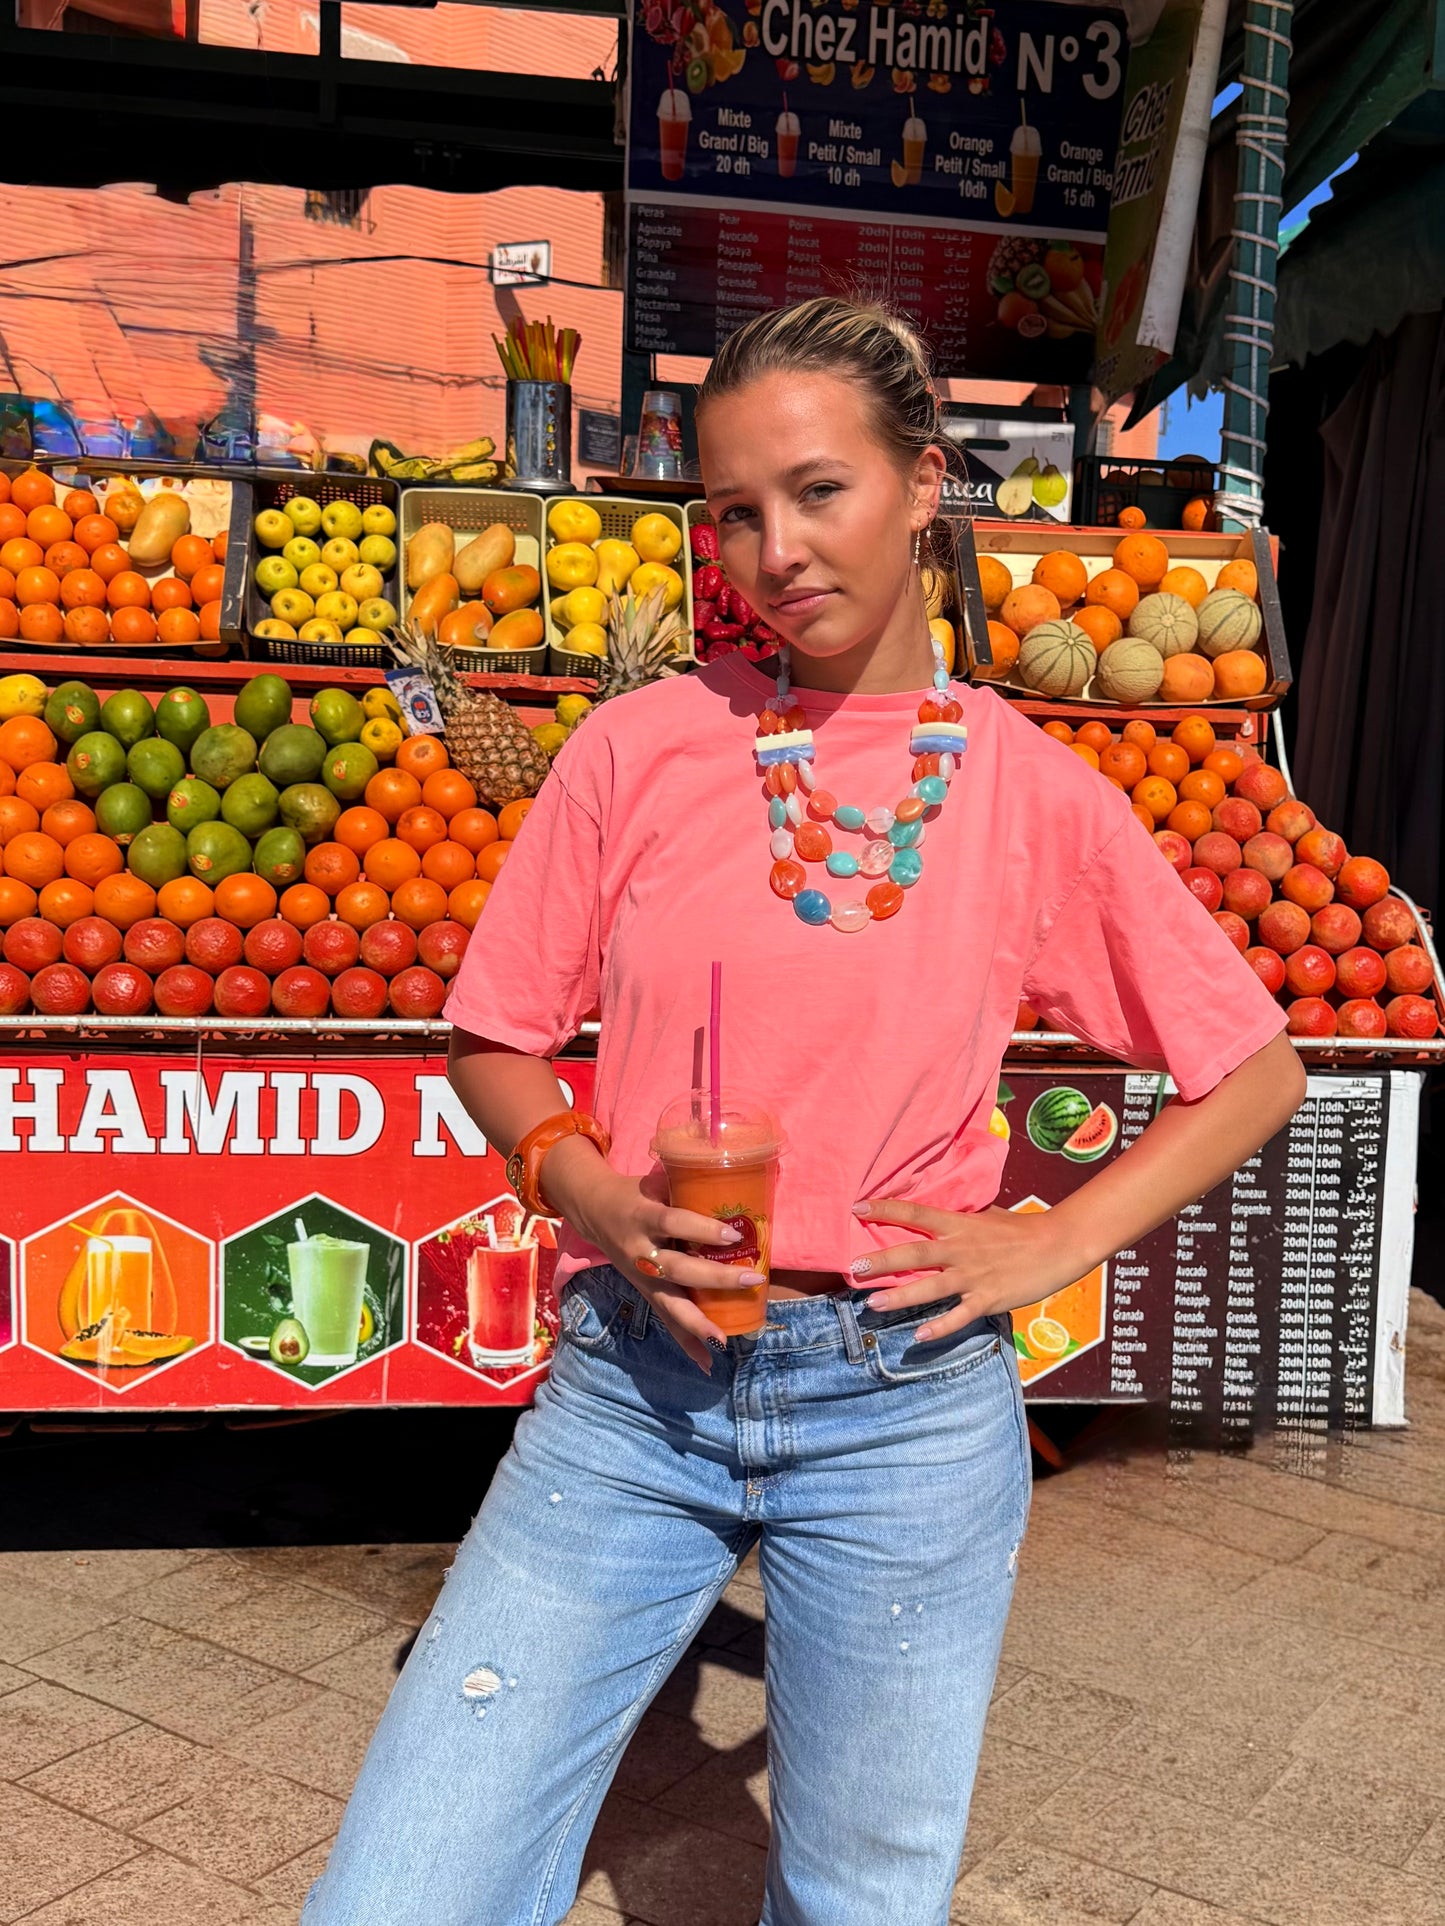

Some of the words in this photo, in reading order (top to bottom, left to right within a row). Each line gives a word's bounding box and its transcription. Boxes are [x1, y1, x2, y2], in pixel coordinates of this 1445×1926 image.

[760, 0, 857, 64] Chez
[868, 4, 988, 76] Hamid
[718, 107, 752, 129] Mixte
[828, 118, 862, 141] Mixte
[699, 129, 740, 154] Grand
[748, 134, 769, 159] Big
[949, 131, 994, 156] Orange
[808, 141, 836, 163] Petit
[846, 145, 881, 167] Small
[1059, 140, 1104, 165] Orange
[716, 155, 731, 174] 20
[733, 154, 751, 176] dh
[935, 154, 963, 177] Petit
[973, 157, 1006, 180] Small
[827, 166, 841, 186] 10
[843, 166, 861, 187] dh
[1047, 163, 1085, 187] Grand
[1094, 168, 1113, 191] Big
[1063, 187, 1078, 207] 15
[1078, 188, 1096, 208] dh
[638, 206, 664, 218] Peras
[718, 213, 740, 226] Pear
[788, 219, 813, 232] Poire
[858, 226, 889, 237] 20dh
[895, 228, 925, 240] 10dh
[638, 222, 682, 237] Aguacate
[718, 230, 759, 243] Avocado
[787, 235, 819, 248] Avocat
[637, 235, 672, 250] Papaya
[717, 244, 752, 258] Papaya
[717, 258, 763, 274] Pineapple
[636, 267, 676, 281] Granada
[717, 276, 757, 289] Grenade
[635, 298, 681, 312] Nectarina
[716, 291, 773, 305] Watermelon
[635, 310, 661, 323] Fresa
[635, 324, 668, 338] Mango
[1124, 1094, 1152, 1108] Naranja
[1320, 1101, 1344, 1112] 10dh
[0, 1067, 386, 1156] HAMID
[1123, 1109, 1149, 1120] Pomelo
[1320, 1115, 1344, 1124] 10dh
[1122, 1123, 1144, 1135] Limon
[1289, 1127, 1314, 1138] 20dh
[1318, 1128, 1343, 1138] 10dh
[1288, 1143, 1313, 1153] 20dh
[1317, 1144, 1342, 1154] 10dh
[1288, 1158, 1312, 1167] 20dh
[1316, 1158, 1341, 1168] 10dh
[1233, 1171, 1256, 1183] Peche
[1287, 1173, 1311, 1183] 20dh
[1316, 1174, 1340, 1184] 10dh
[1232, 1187, 1267, 1199] Pruneaux
[1286, 1189, 1310, 1199] 20dh
[1315, 1190, 1340, 1200] 10dh
[1232, 1203, 1272, 1217] Gingembre
[1285, 1206, 1310, 1216] 20dh
[1314, 1207, 1339, 1217] 10dh
[1178, 1220, 1217, 1232] Persimmon
[1231, 1221, 1247, 1232] Kaki
[1284, 1222, 1309, 1232] 20dh
[1313, 1223, 1338, 1234] 10dh
[1177, 1235, 1194, 1246] Kiwi
[1230, 1236, 1246, 1247] Kiwi
[1283, 1237, 1308, 1247] 20dh
[1312, 1238, 1337, 1248] 10dh
[1176, 1249, 1194, 1261] Pear
[1229, 1250, 1249, 1262] Poire
[1282, 1251, 1307, 1262] 20dh
[1311, 1252, 1336, 1263] 10dh
[1115, 1265, 1149, 1278] Aguacate
[1176, 1266, 1207, 1277] Avocado
[1228, 1266, 1253, 1277] Avocat
[1282, 1267, 1306, 1277] 20dh
[1310, 1268, 1335, 1278] 10dh
[1114, 1279, 1141, 1292] Papaya
[1175, 1279, 1201, 1293] Papaya
[1228, 1280, 1255, 1294] Papaye
[1281, 1283, 1306, 1293] 20dh
[1310, 1284, 1334, 1294] 10dh
[1175, 1295, 1211, 1308] Pineapple
[1227, 1295, 1254, 1307] Ananas
[1280, 1298, 1305, 1309] 20dh
[1309, 1299, 1334, 1309] 10dh
[1113, 1310, 1144, 1321] Granada
[1174, 1311, 1205, 1323] Grenade
[1226, 1311, 1257, 1324] Grenade
[1280, 1313, 1304, 1324] 30dh
[1309, 1314, 1332, 1324] 15dh
[1173, 1326, 1218, 1337] Watermelon
[1226, 1326, 1260, 1339] Pasteque
[1279, 1328, 1304, 1339] 20dh
[1308, 1329, 1332, 1339] 10dh
[1112, 1340, 1147, 1352] Nectarina
[1173, 1341, 1208, 1353] Nectarine
[1225, 1341, 1261, 1353] Nectarine
[1279, 1343, 1303, 1353] 20dh
[1307, 1344, 1332, 1354] 10dh
[1111, 1353, 1131, 1365] Fresa
[1172, 1354, 1213, 1368] Strawberry
[1225, 1356, 1248, 1367] Fraise
[1278, 1357, 1303, 1367] 20dh
[1307, 1358, 1331, 1368] 10dh
[1112, 1367, 1136, 1381] Mango
[1172, 1368, 1197, 1382] Mango
[1224, 1368, 1253, 1382] Mangue
[1278, 1371, 1302, 1381] 20dh
[1306, 1371, 1331, 1382] 10dh
[1111, 1381, 1143, 1394] Pitahaya
